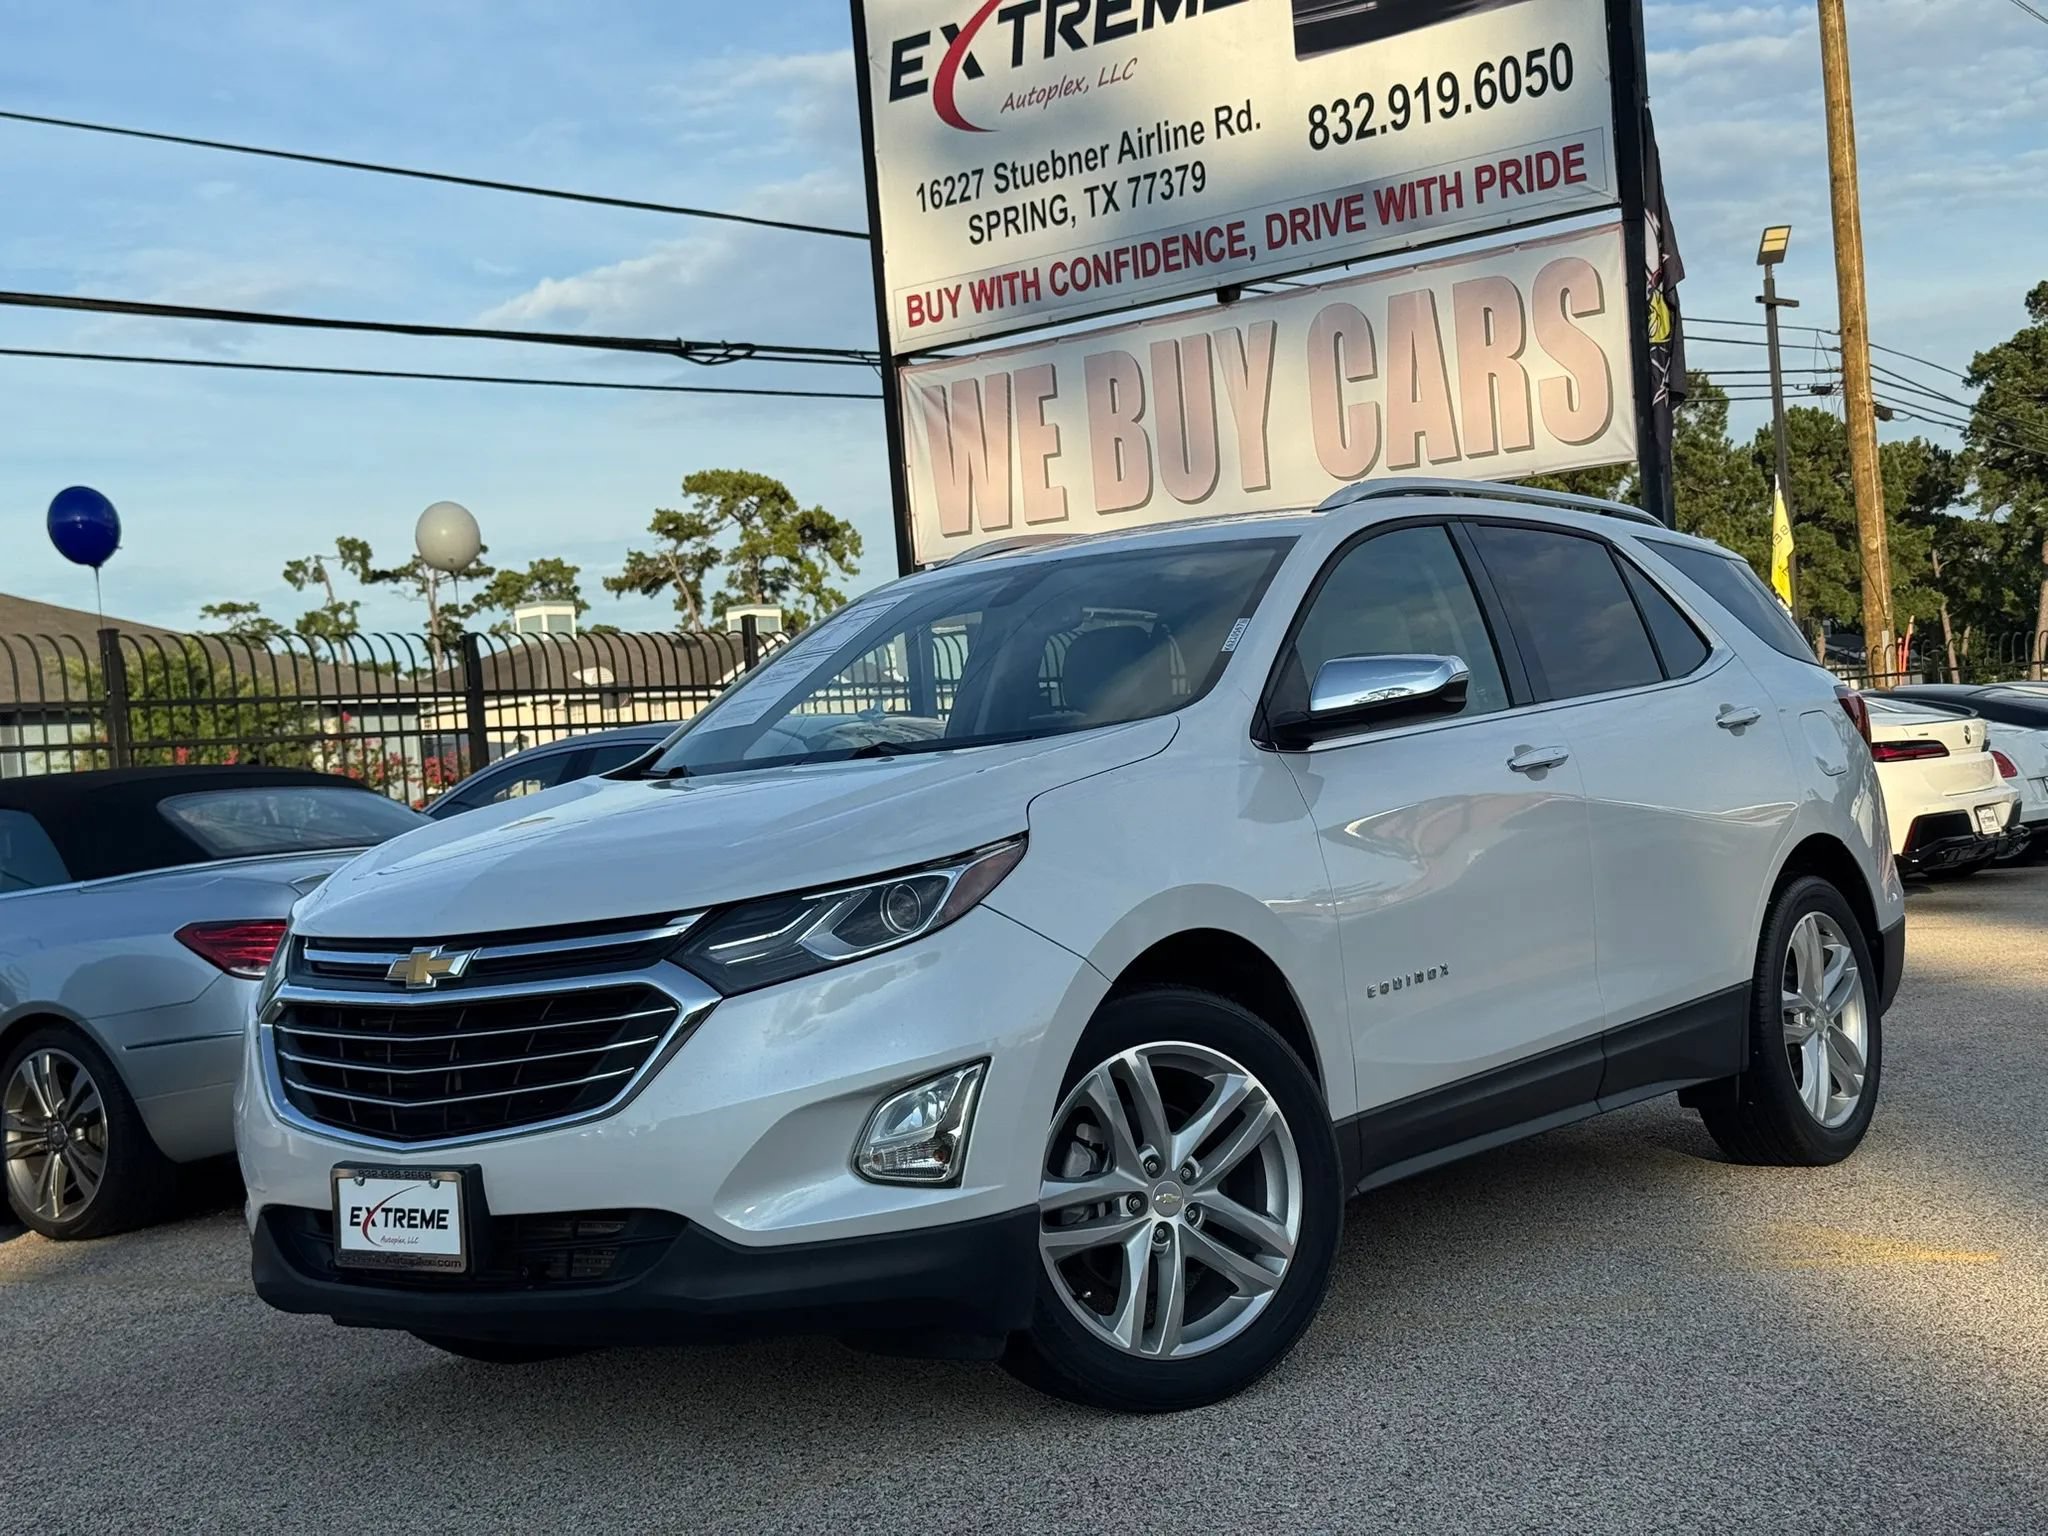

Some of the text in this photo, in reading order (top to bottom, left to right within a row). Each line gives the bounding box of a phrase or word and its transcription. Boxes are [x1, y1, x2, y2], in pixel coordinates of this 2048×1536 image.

[889, 0, 1251, 103] EXTRE
[1000, 58, 1138, 113] Autoplex, LLC
[1308, 42, 1573, 150] 832.919.6050
[917, 99, 1262, 212] 16227 Stuebner Airline Rd.
[969, 161, 1207, 245] SPRING, TX 77379
[906, 143, 1588, 328] BUY WITH CONFIDENCE, DRIVE WITH PRIDE
[927, 256, 1613, 537] WE BUY CARS
[1366, 963, 1449, 998] EQUINOX
[349, 1206, 450, 1230] EXTREME
